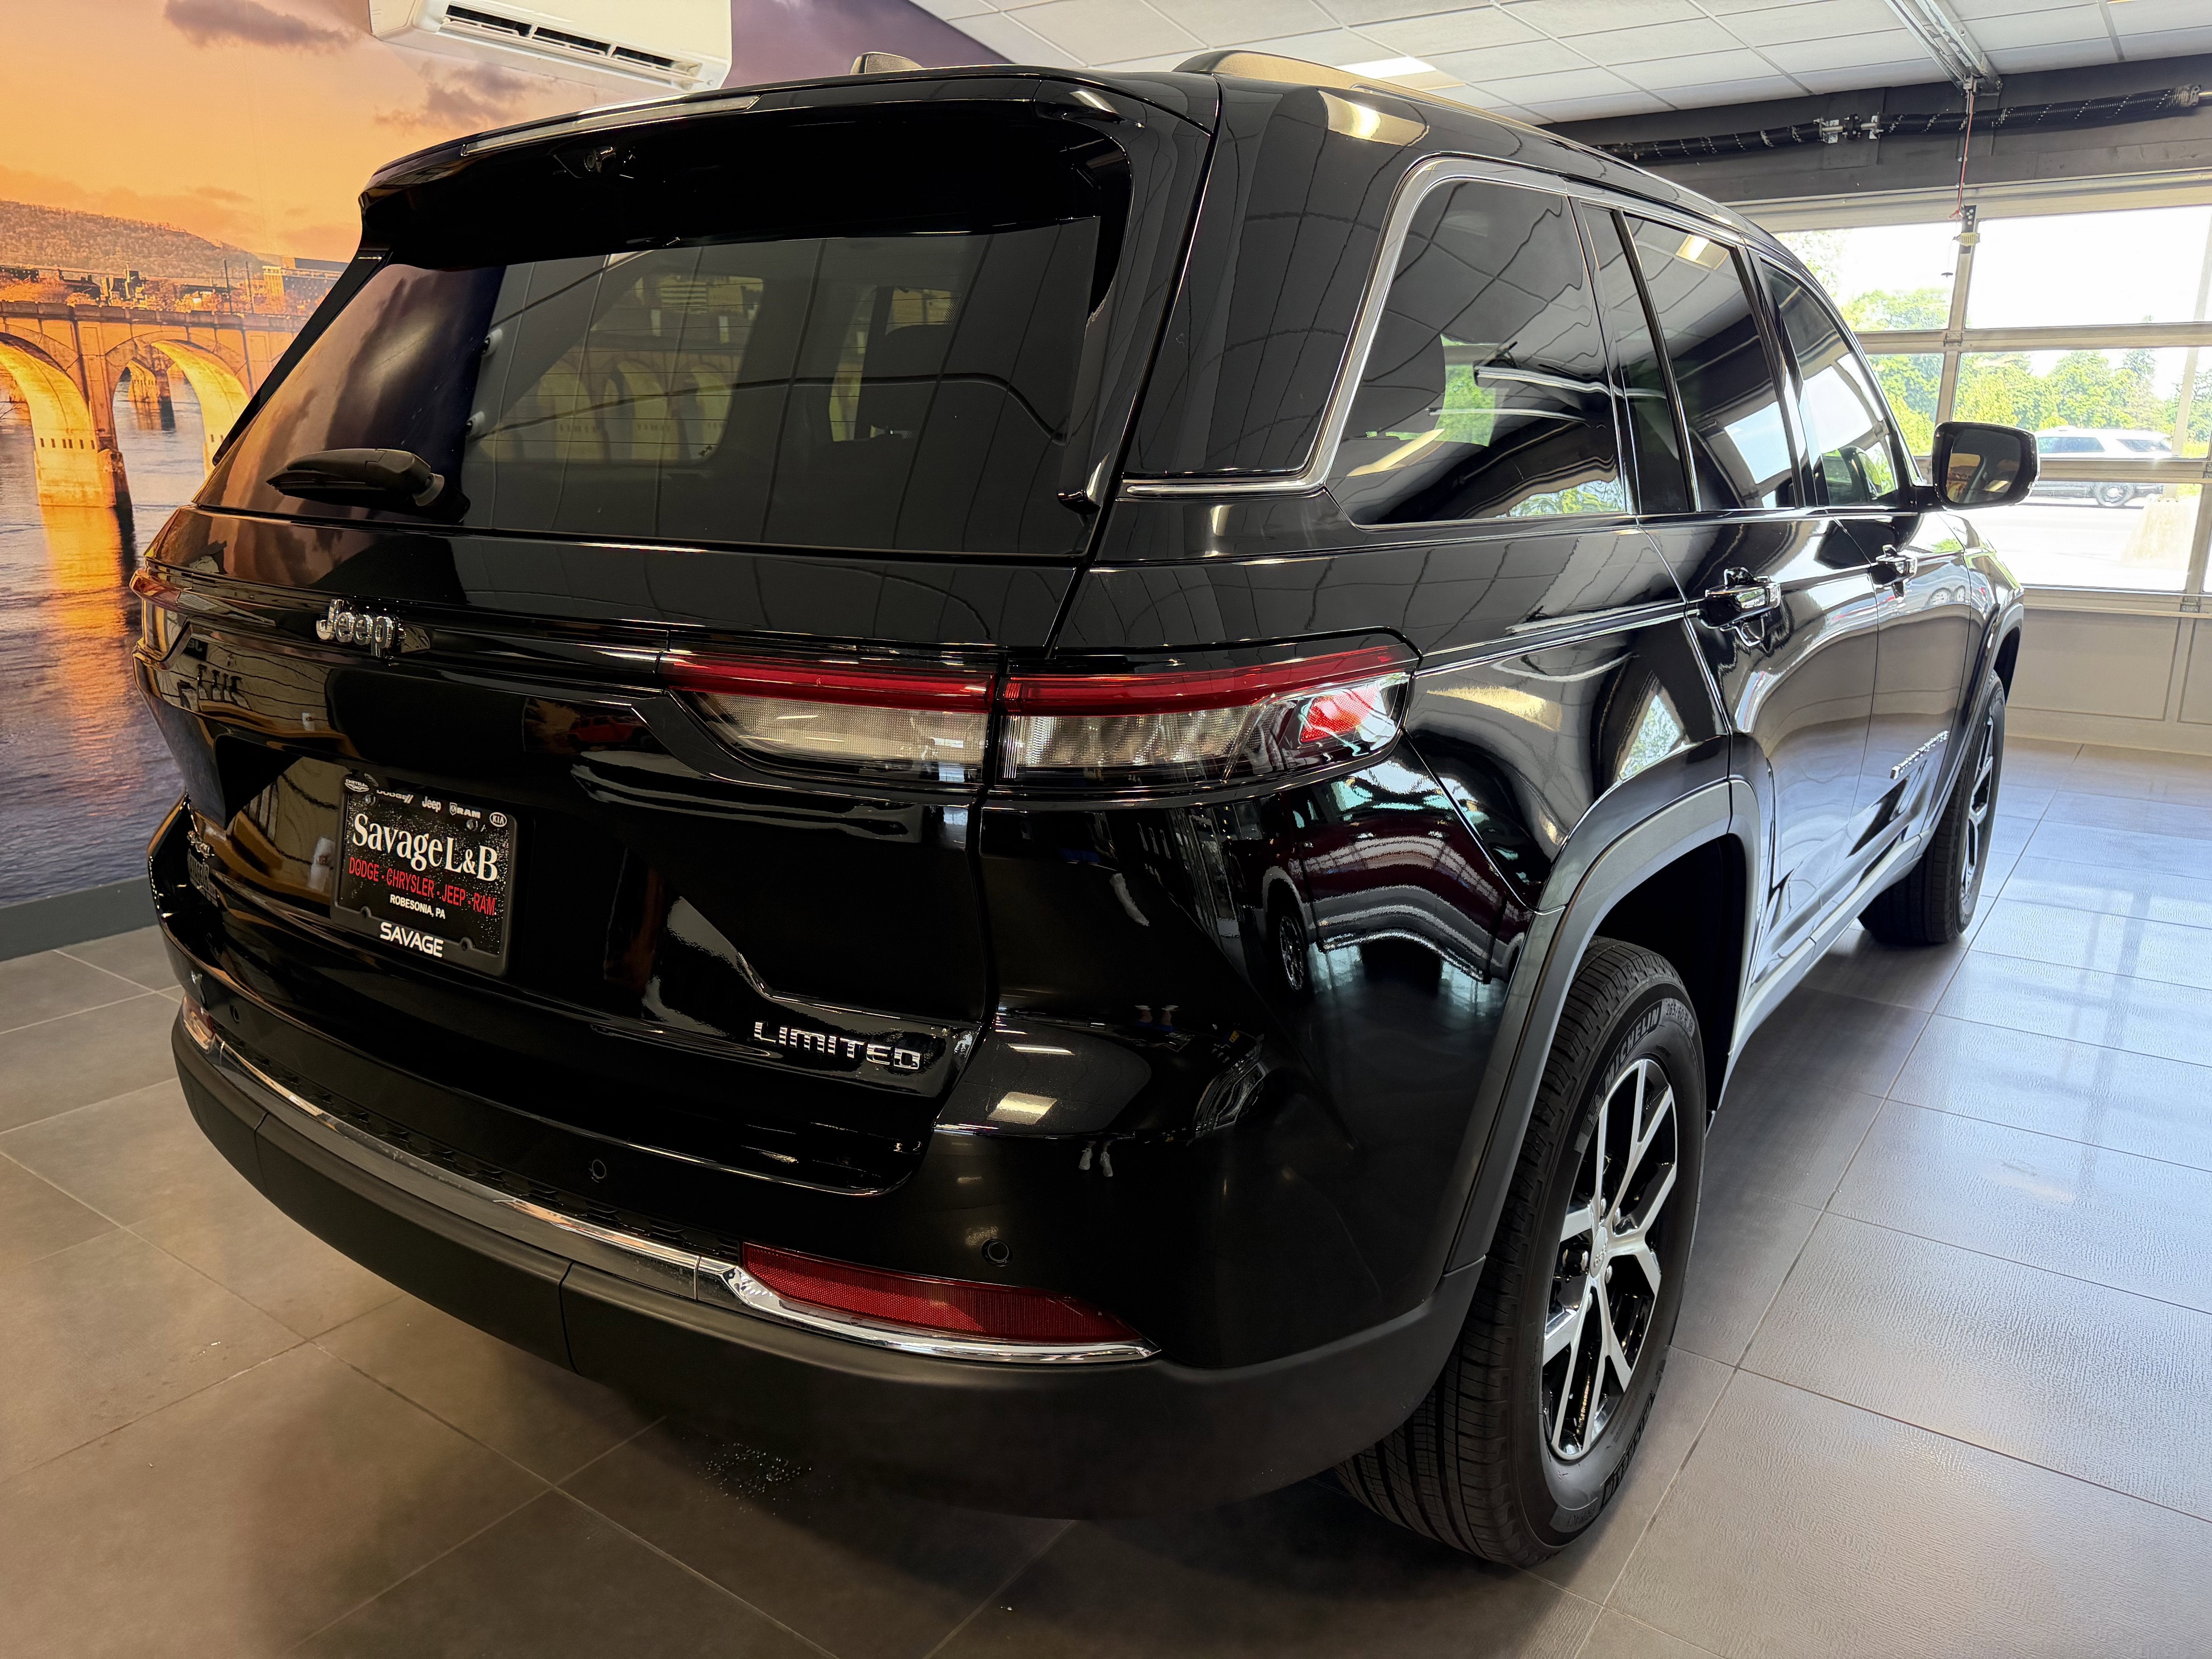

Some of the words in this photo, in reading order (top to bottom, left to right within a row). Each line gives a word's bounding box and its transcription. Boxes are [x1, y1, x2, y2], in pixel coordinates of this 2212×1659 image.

[316, 599, 395, 658] Jeep
[422, 796, 441, 812] Jeep
[457, 807, 481, 819] RAM
[492, 814, 505, 825] KIA
[349, 856, 380, 882] DODGE
[386, 867, 434, 899] CHRYSLER
[441, 884, 466, 907] JEEP
[473, 892, 496, 917] RAM
[390, 894, 434, 918] ROBESONIA,
[435, 907, 446, 920] PA
[380, 922, 444, 958] SAVAGE
[754, 1021, 921, 1070] LIMITED
[1604, 1007, 1659, 1094] MICHELIN
